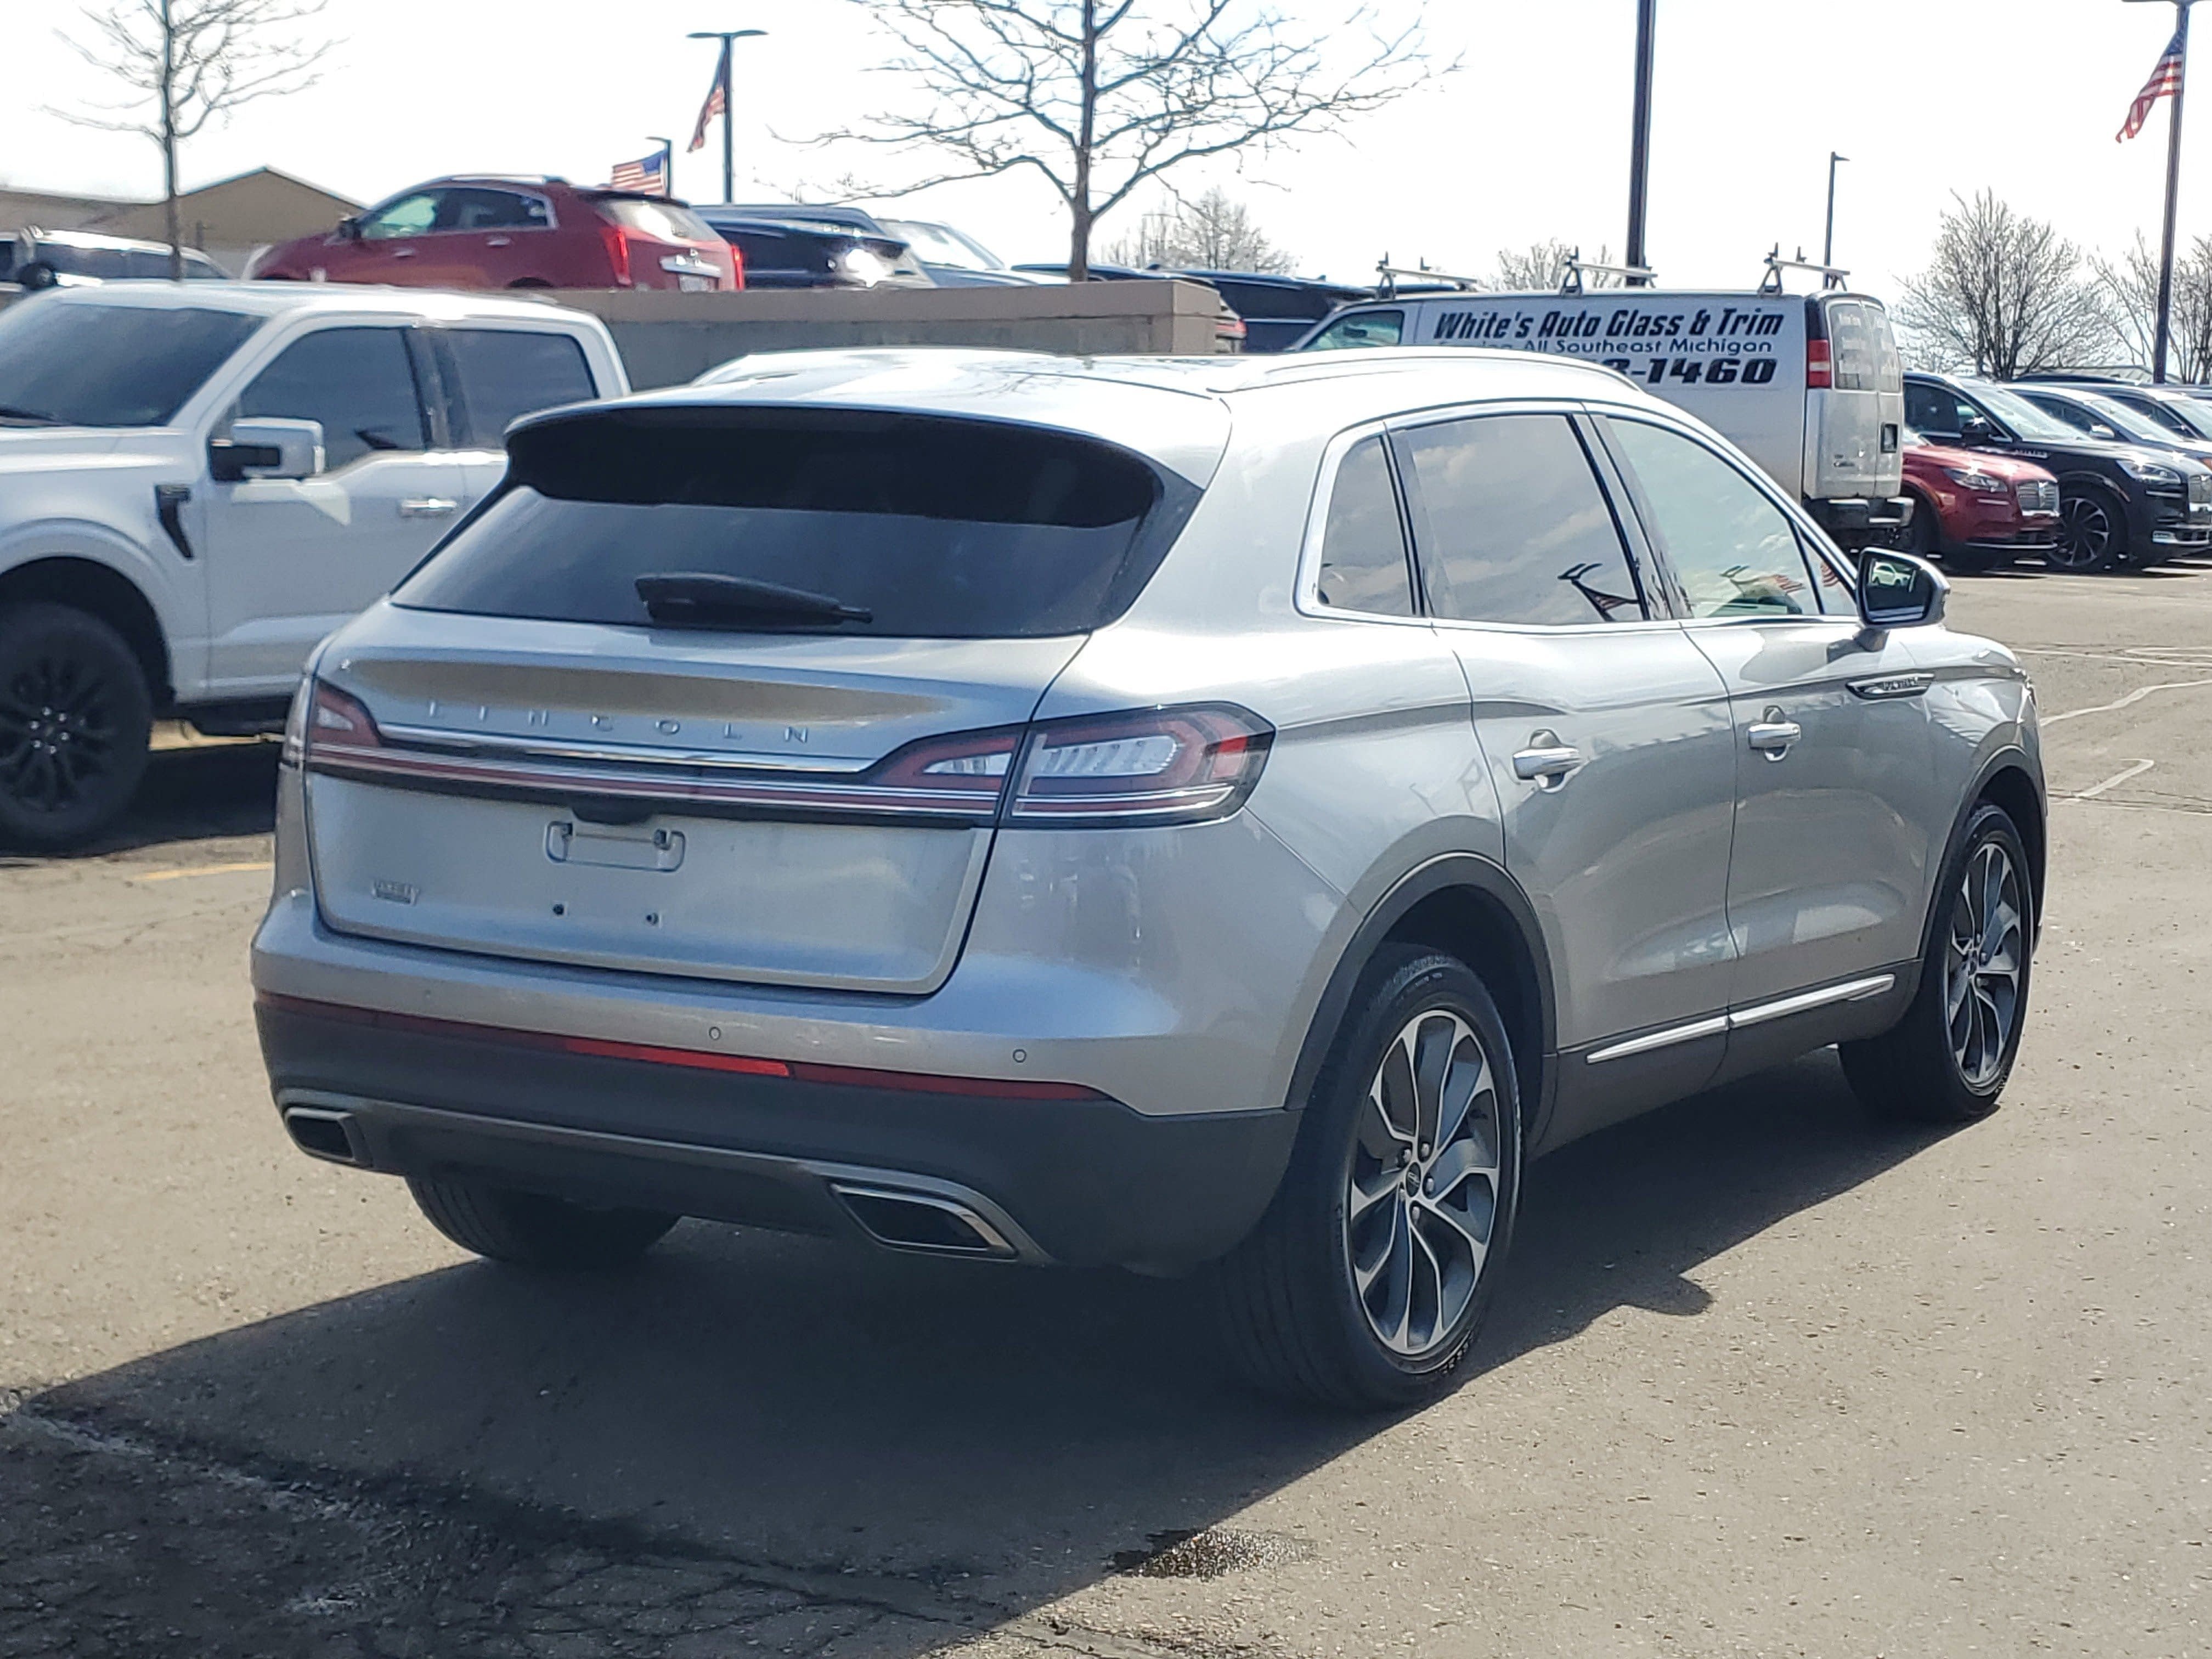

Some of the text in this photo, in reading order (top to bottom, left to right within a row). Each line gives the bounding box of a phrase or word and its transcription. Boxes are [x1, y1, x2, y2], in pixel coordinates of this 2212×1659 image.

[1433, 307, 1784, 339] White's Auto Glass & Trim
[1524, 340, 1548, 353] All
[1555, 338, 1662, 354] Southeast
[1669, 337, 1773, 356] Michigan
